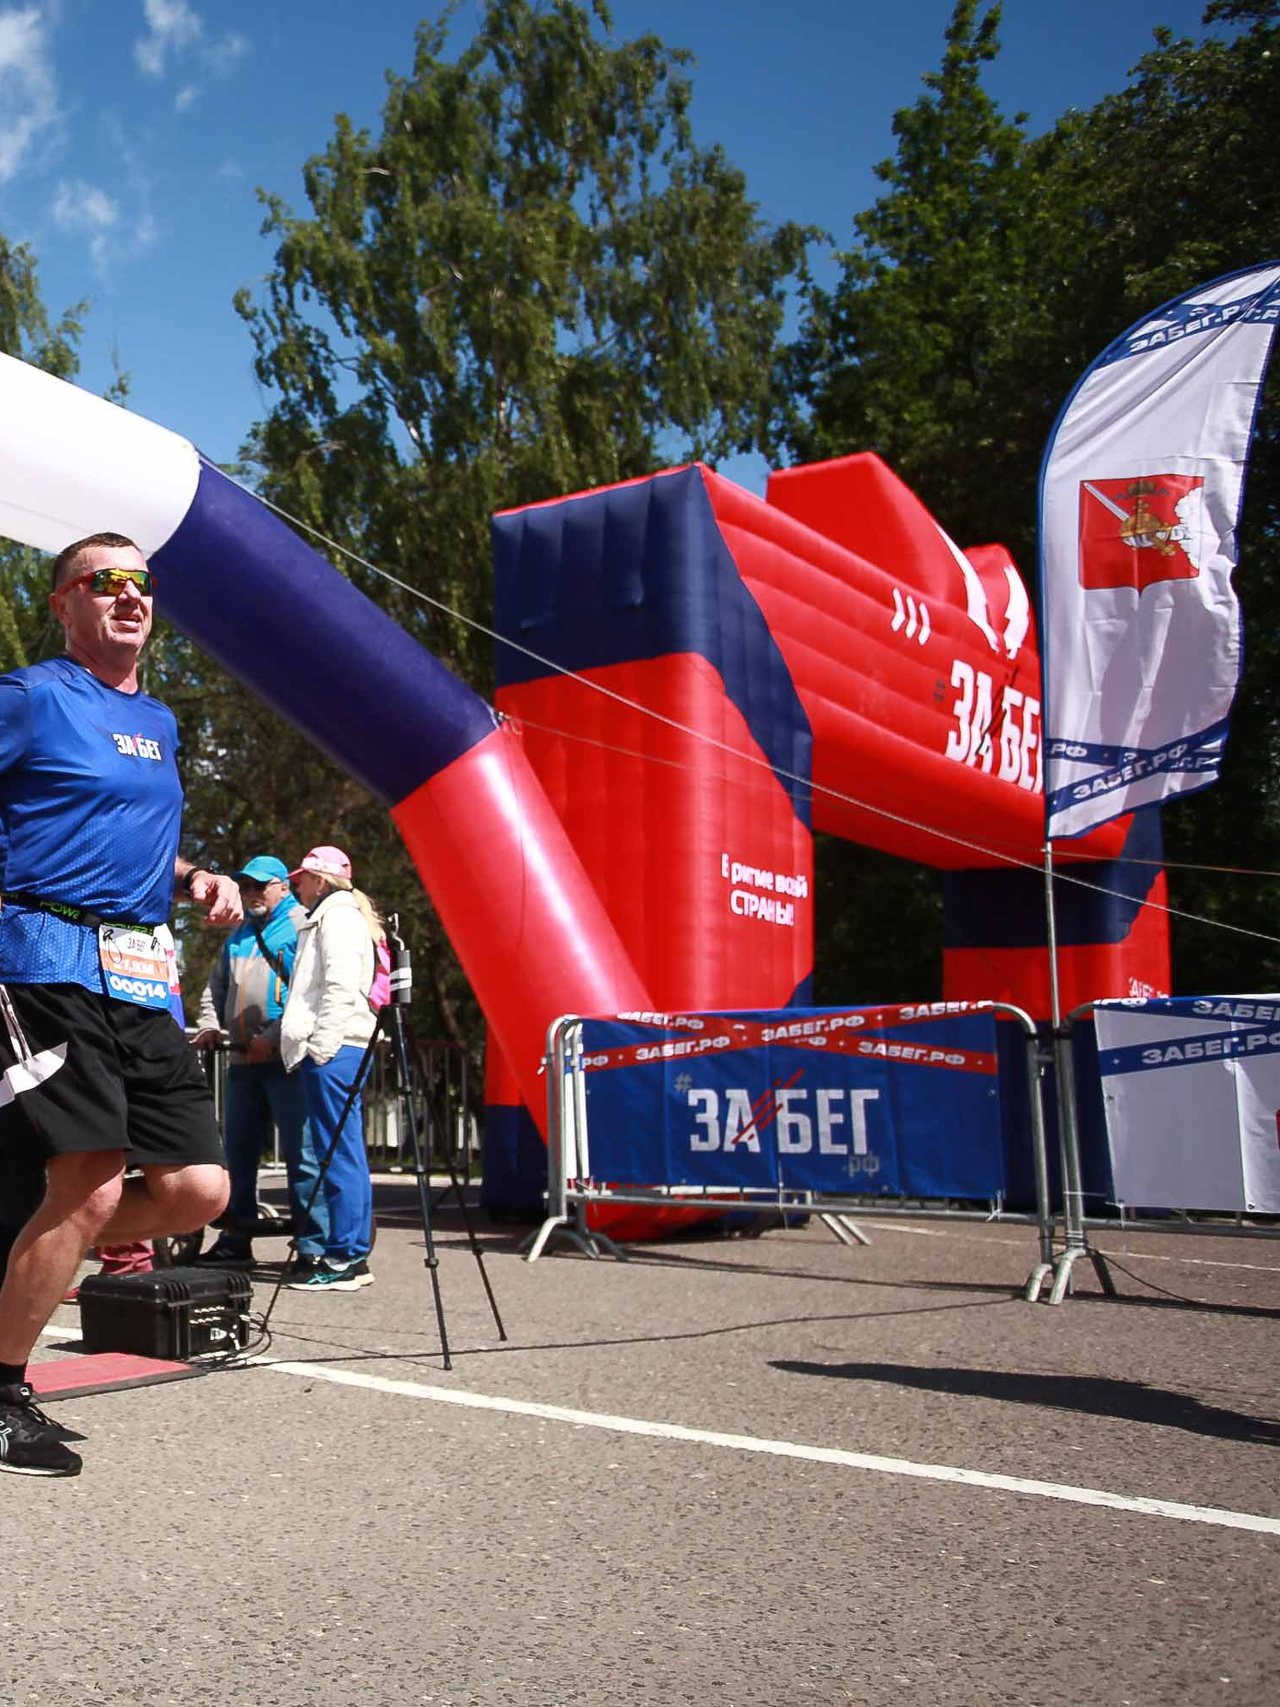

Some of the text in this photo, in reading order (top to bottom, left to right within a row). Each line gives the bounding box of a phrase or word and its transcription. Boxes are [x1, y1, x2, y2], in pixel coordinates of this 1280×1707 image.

[112, 733, 162, 761] ЗАБЕГ
[109, 975, 167, 1000] 00014
[760, 1014, 866, 1042] ЗАБЕГ.РФ
[635, 1035, 731, 1061] ЗАБЕГ.РФ
[858, 1040, 966, 1066] ЗАБЕГ.РФ
